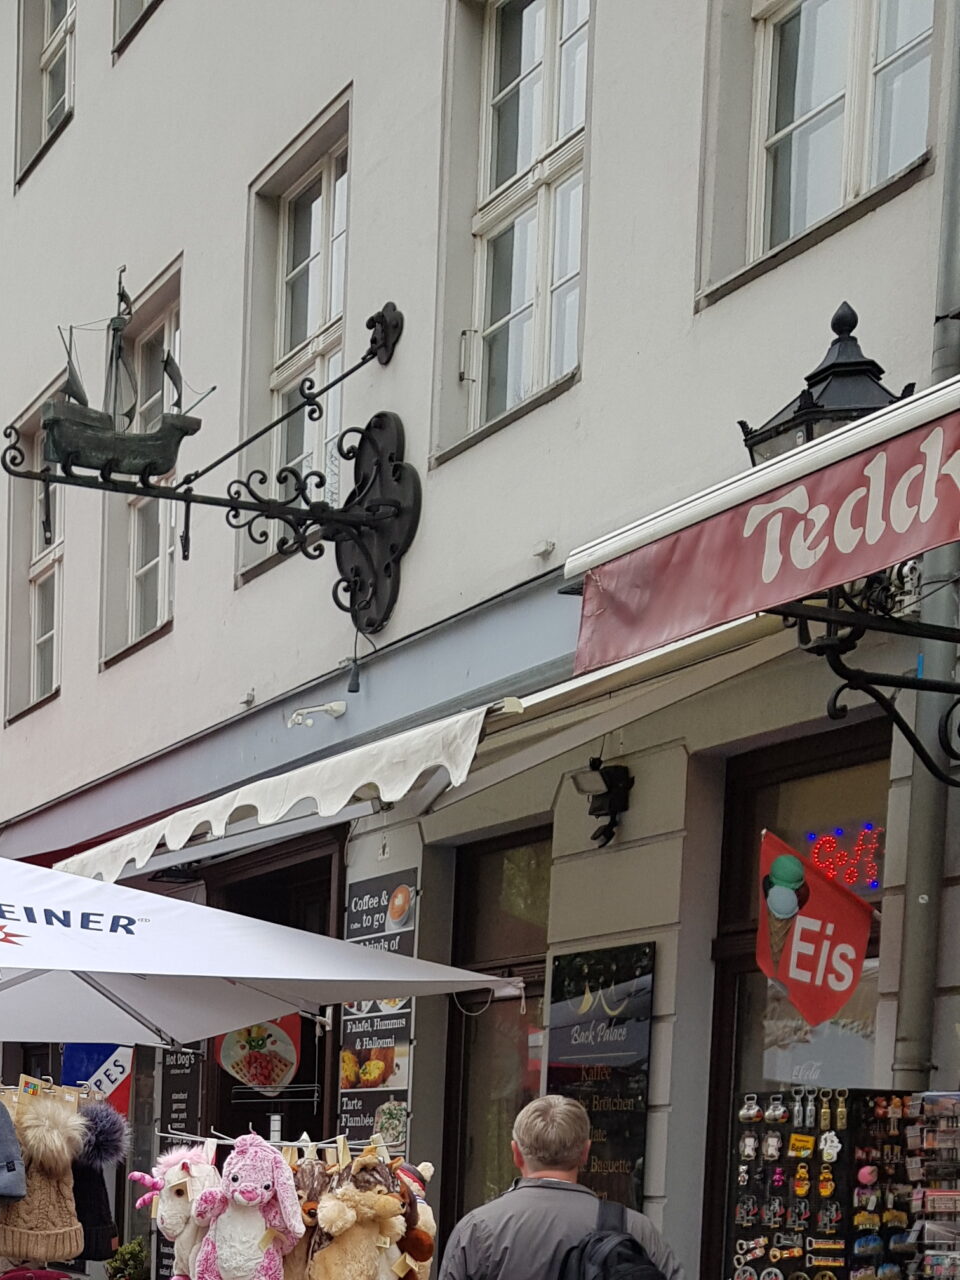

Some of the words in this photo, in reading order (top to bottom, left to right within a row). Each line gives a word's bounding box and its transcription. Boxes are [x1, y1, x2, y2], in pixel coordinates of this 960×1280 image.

[812, 828, 885, 868] Coff
[351, 894, 379, 912] Coffee
[381, 890, 389, 905] &
[363, 913, 371, 927] to
[373, 913, 385, 928] go
[390, 936, 400, 951] of
[789, 915, 857, 991] Eis
[571, 1020, 595, 1045] Back
[597, 1018, 628, 1043] Palace
[93, 1059, 125, 1094] PES
[342, 1097, 362, 1110] Tarte
[592, 1094, 634, 1112] Brötchen
[341, 1112, 374, 1126] Flambée
[591, 1155, 632, 1176] Baguette
